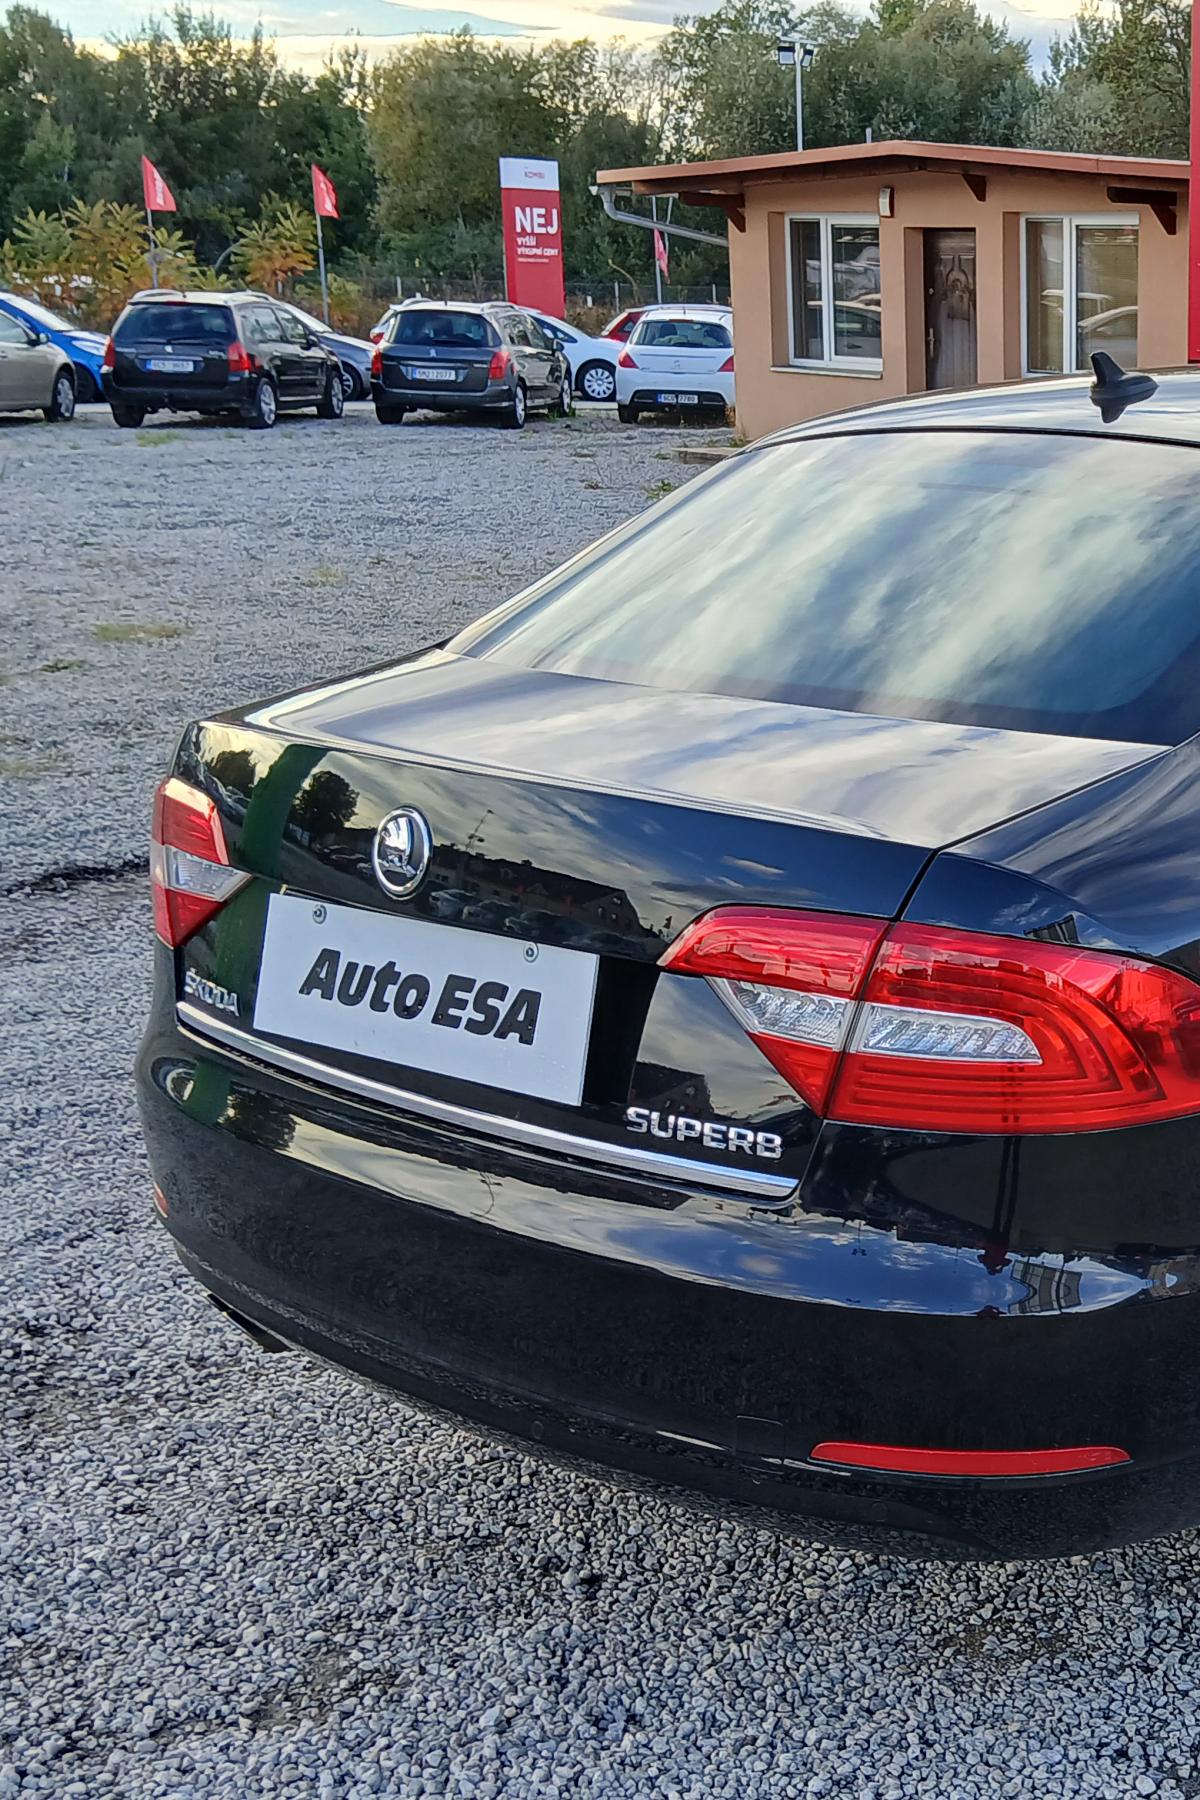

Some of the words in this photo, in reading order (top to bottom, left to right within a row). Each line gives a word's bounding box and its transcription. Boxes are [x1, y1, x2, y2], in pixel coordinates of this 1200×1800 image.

[514, 206, 559, 235] NEJ
[184, 967, 240, 1017] ŠKODA
[298, 948, 431, 1019] Auto
[431, 974, 542, 1046] ESA
[626, 1106, 785, 1159] SUPERB
